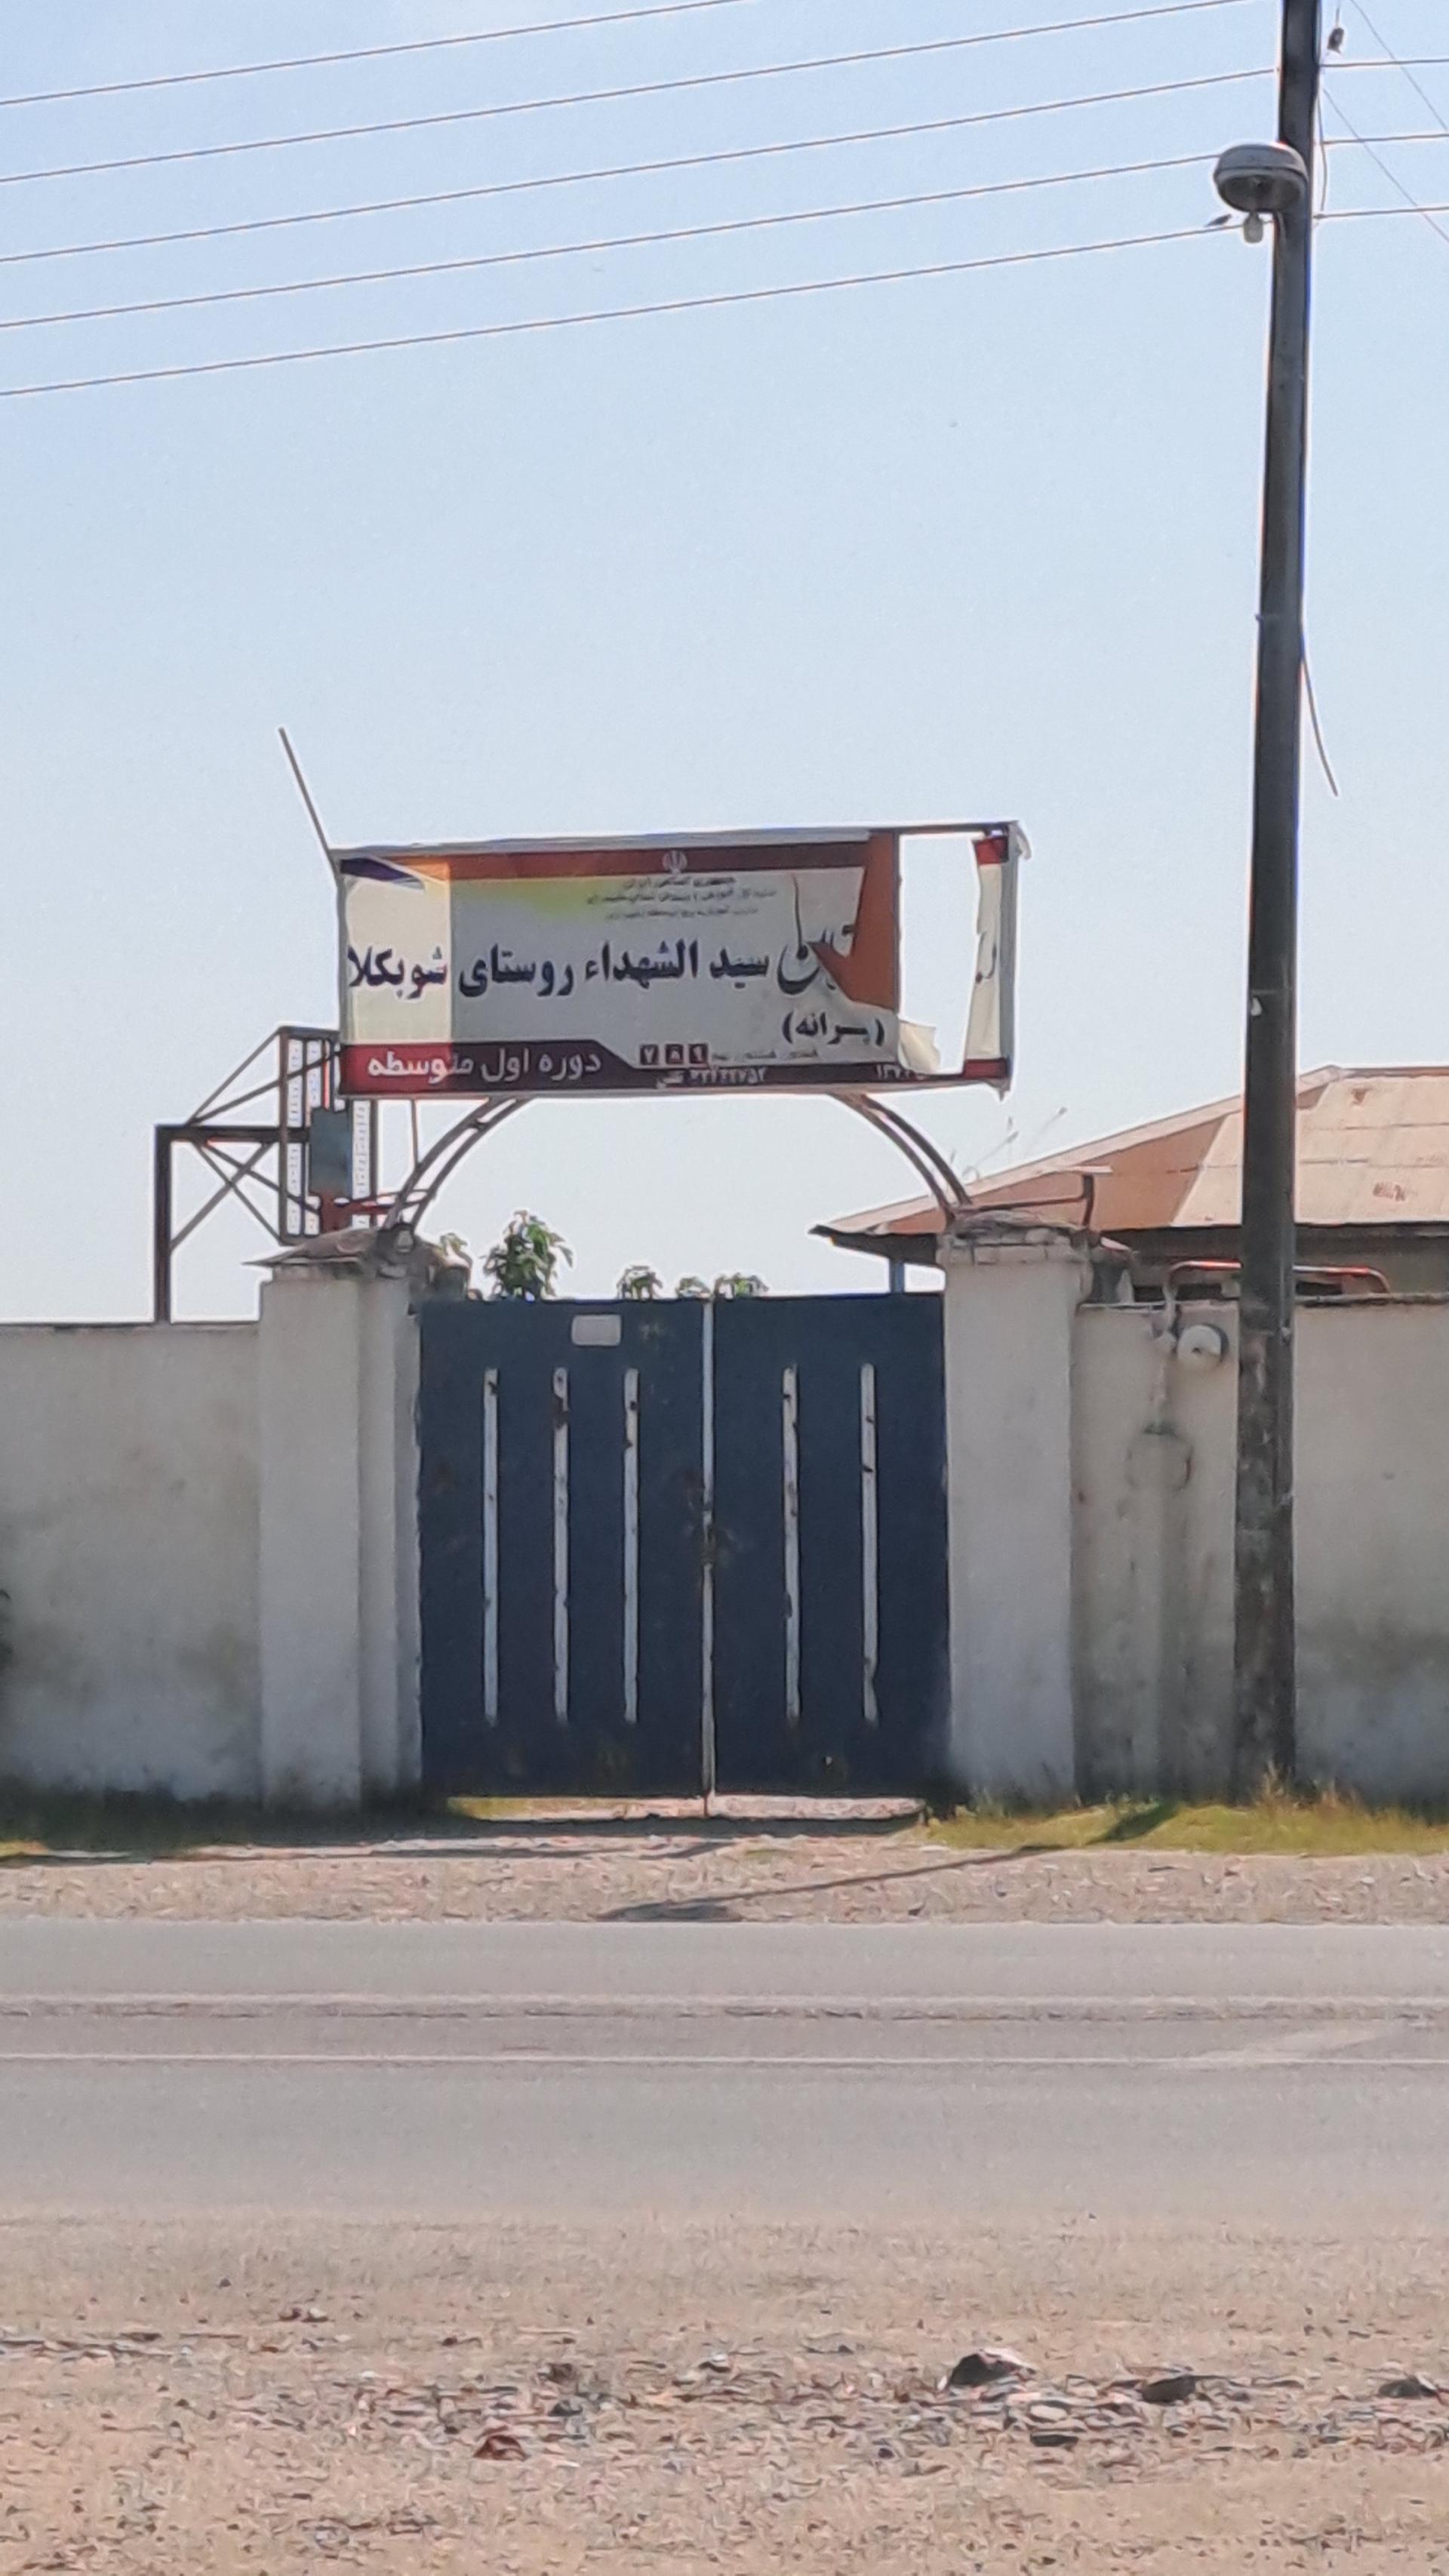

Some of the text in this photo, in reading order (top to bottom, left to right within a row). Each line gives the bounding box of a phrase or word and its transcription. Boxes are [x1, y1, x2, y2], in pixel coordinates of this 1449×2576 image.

[346, 945, 448, 999] شوبکلا
[458, 943, 574, 996] روستای
[584, 937, 699, 989] الشهداء
[709, 948, 770, 989] سید
[368, 1048, 601, 1085] دوره اول متوسطه
